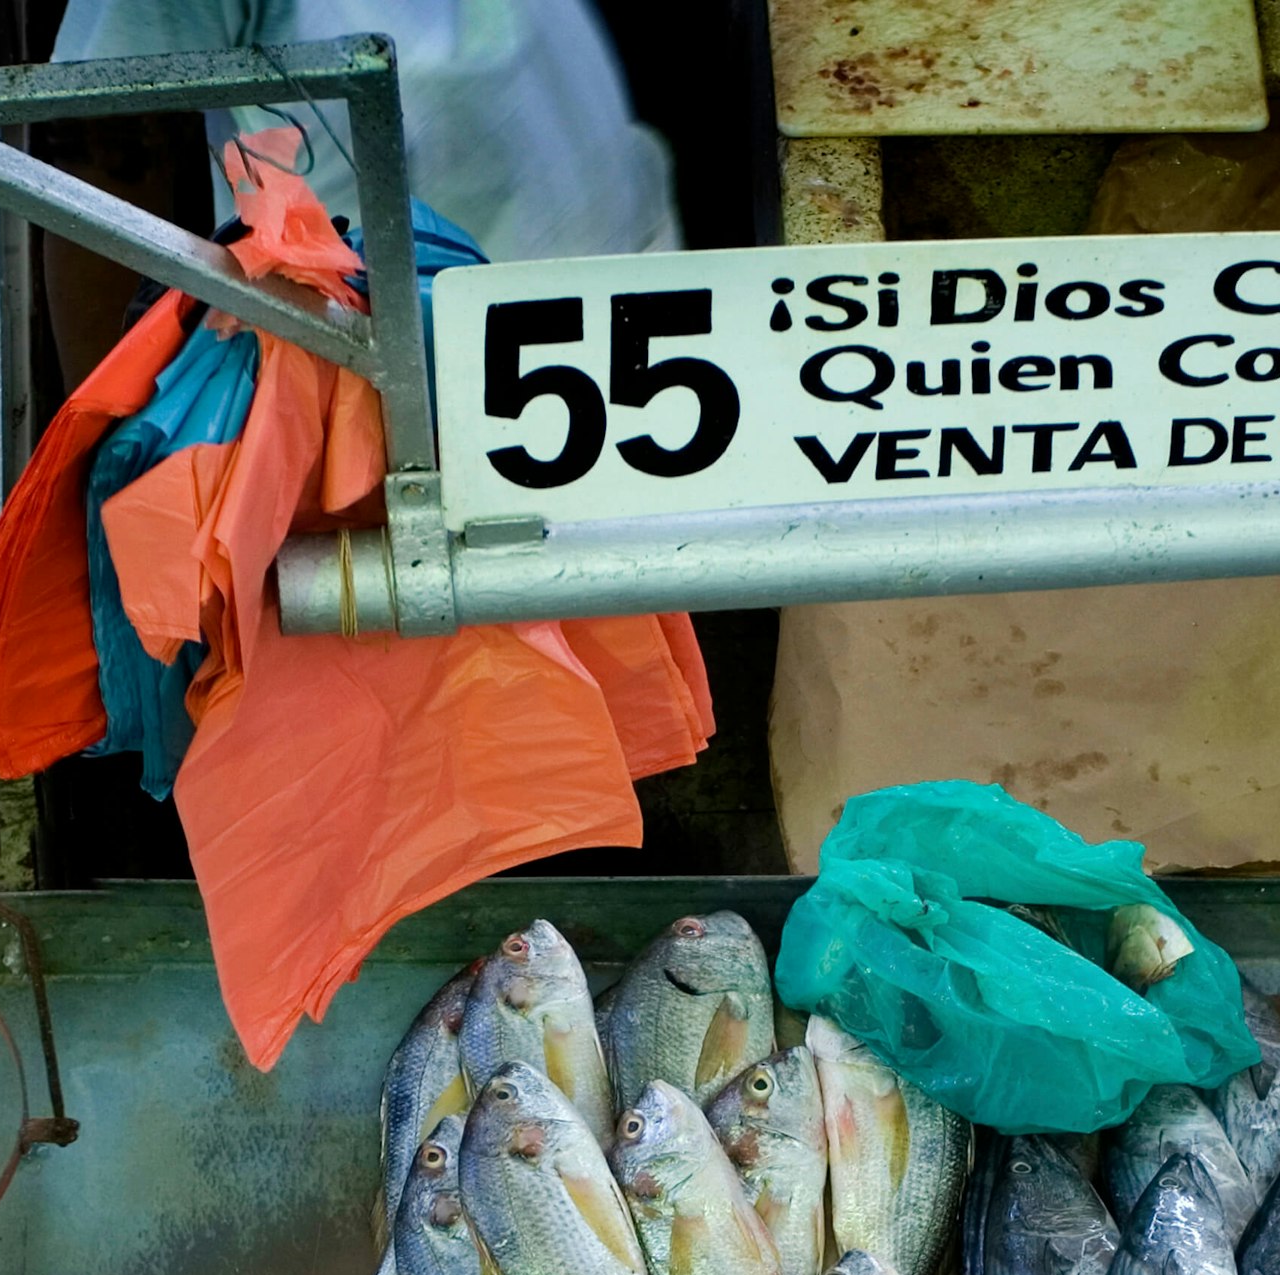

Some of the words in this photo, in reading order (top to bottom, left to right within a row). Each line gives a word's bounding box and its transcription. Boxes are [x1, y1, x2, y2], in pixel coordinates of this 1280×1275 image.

[769, 272, 900, 333] ¡Si
[930, 263, 1165, 326] Dios
[484, 288, 741, 489] 55
[799, 340, 1113, 410] Quien
[794, 419, 1138, 484] VENTA
[1167, 414, 1276, 467] DE
